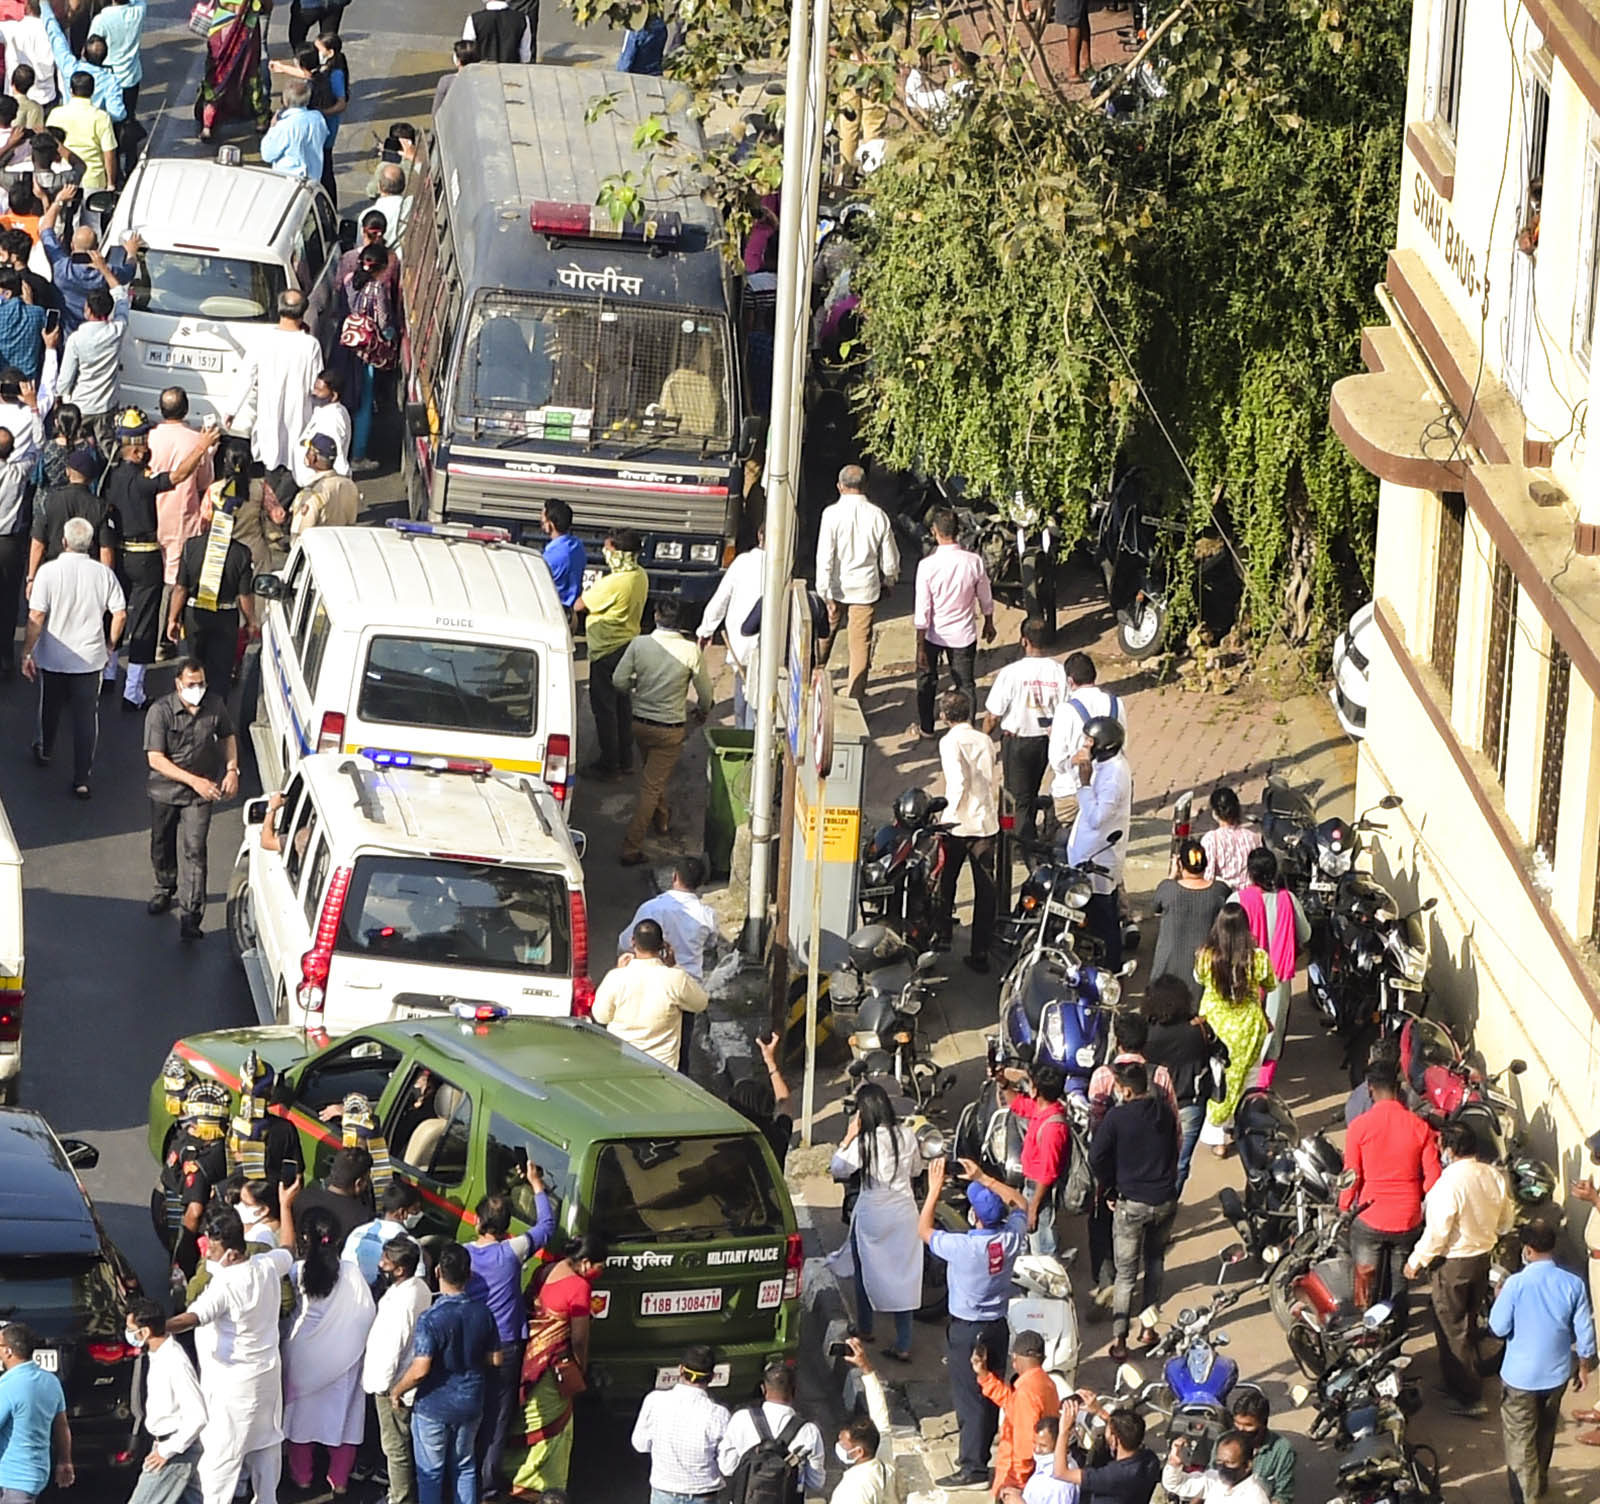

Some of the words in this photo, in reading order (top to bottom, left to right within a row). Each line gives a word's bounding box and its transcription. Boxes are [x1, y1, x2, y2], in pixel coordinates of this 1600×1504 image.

[1413, 171, 1443, 249] SHAH
[557, 262, 645, 296] पोलीस
[149, 351, 162, 362] MH
[180, 353, 193, 366] AN
[198, 354, 217, 368] 1517
[436, 616, 474, 628] POLICE
[630, 1251, 674, 1271] पुलिस
[707, 1251, 748, 1266] MILITARY
[748, 1248, 779, 1263] POLICE
[653, 1298, 672, 1313] 18B
[676, 1295, 721, 1311] 130847M
